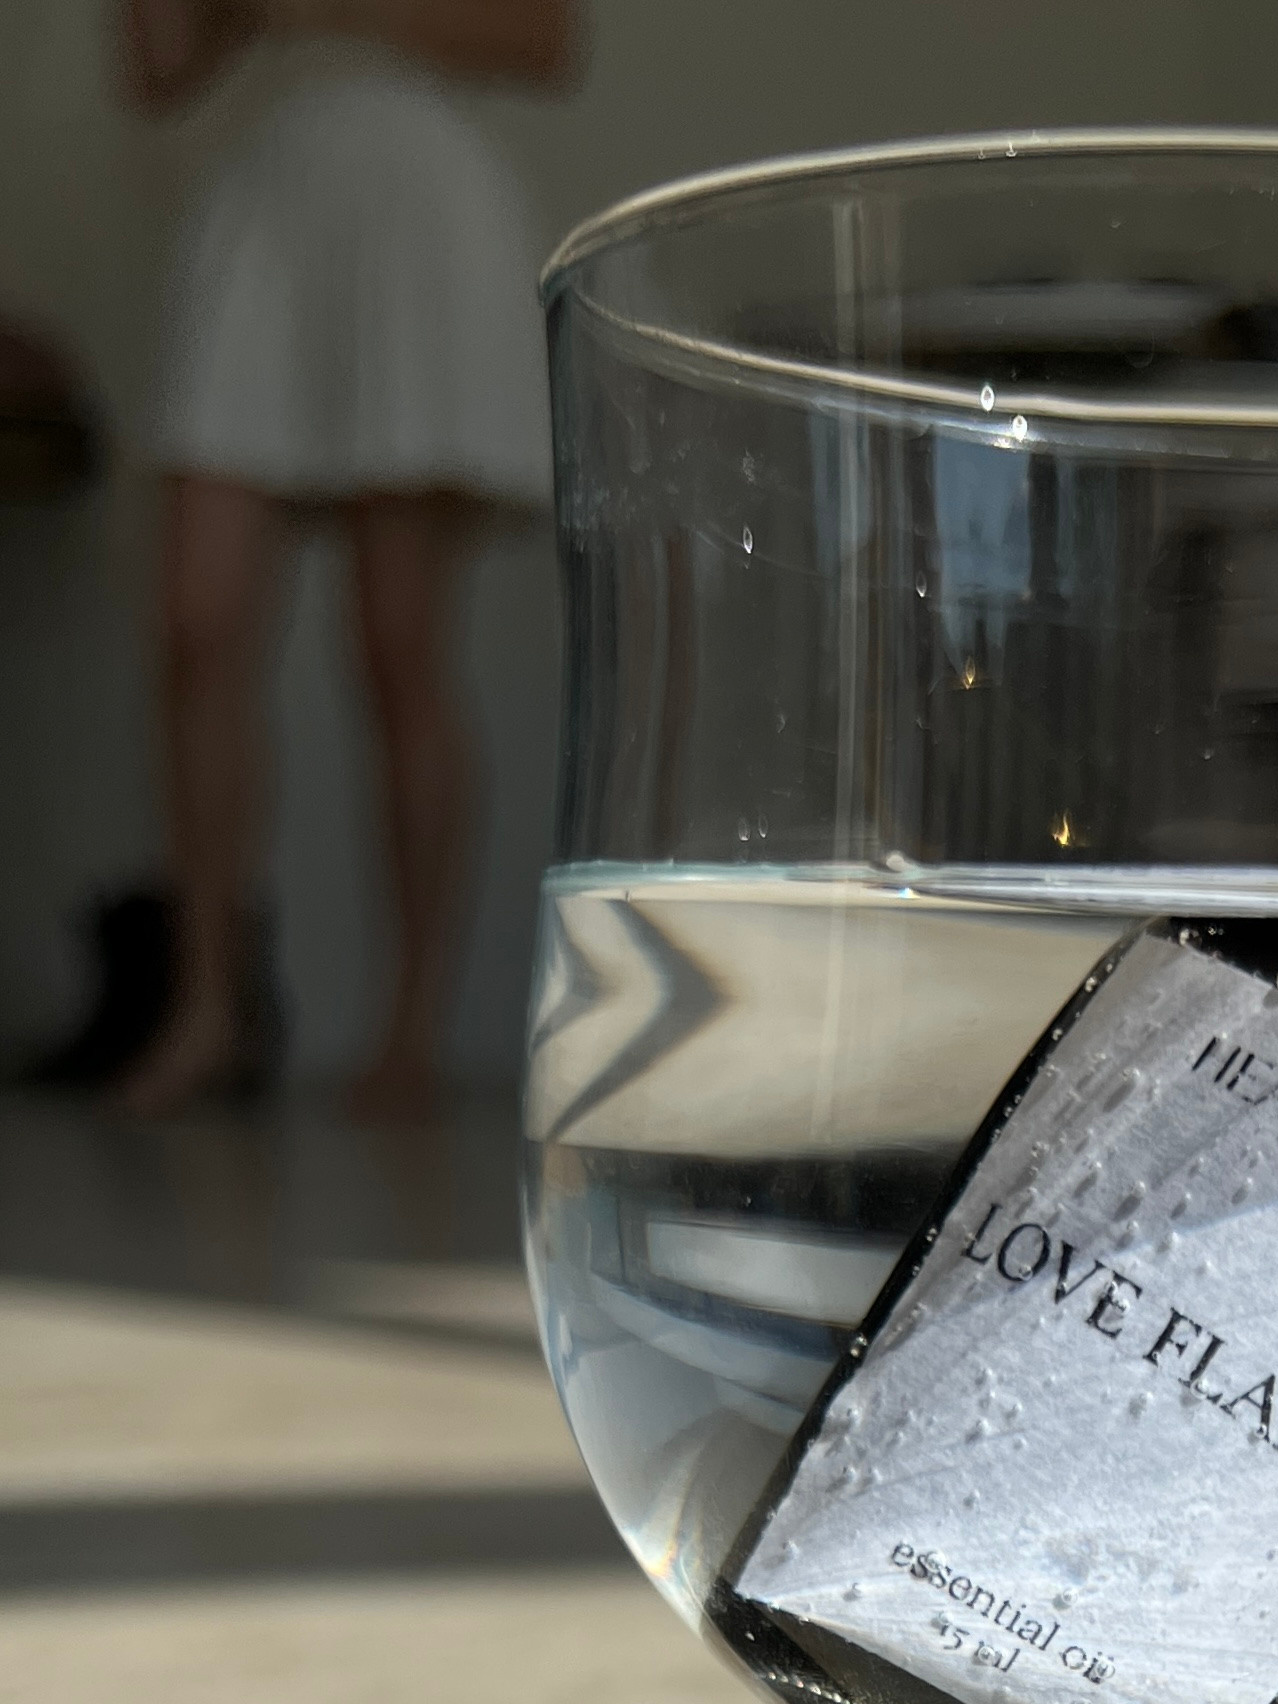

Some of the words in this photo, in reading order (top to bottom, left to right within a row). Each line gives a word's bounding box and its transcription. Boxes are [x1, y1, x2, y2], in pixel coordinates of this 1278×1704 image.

[960, 1203, 1143, 1340] LOVE
[889, 1540, 1061, 1651] essential
[972, 1638, 1022, 1674] ml
